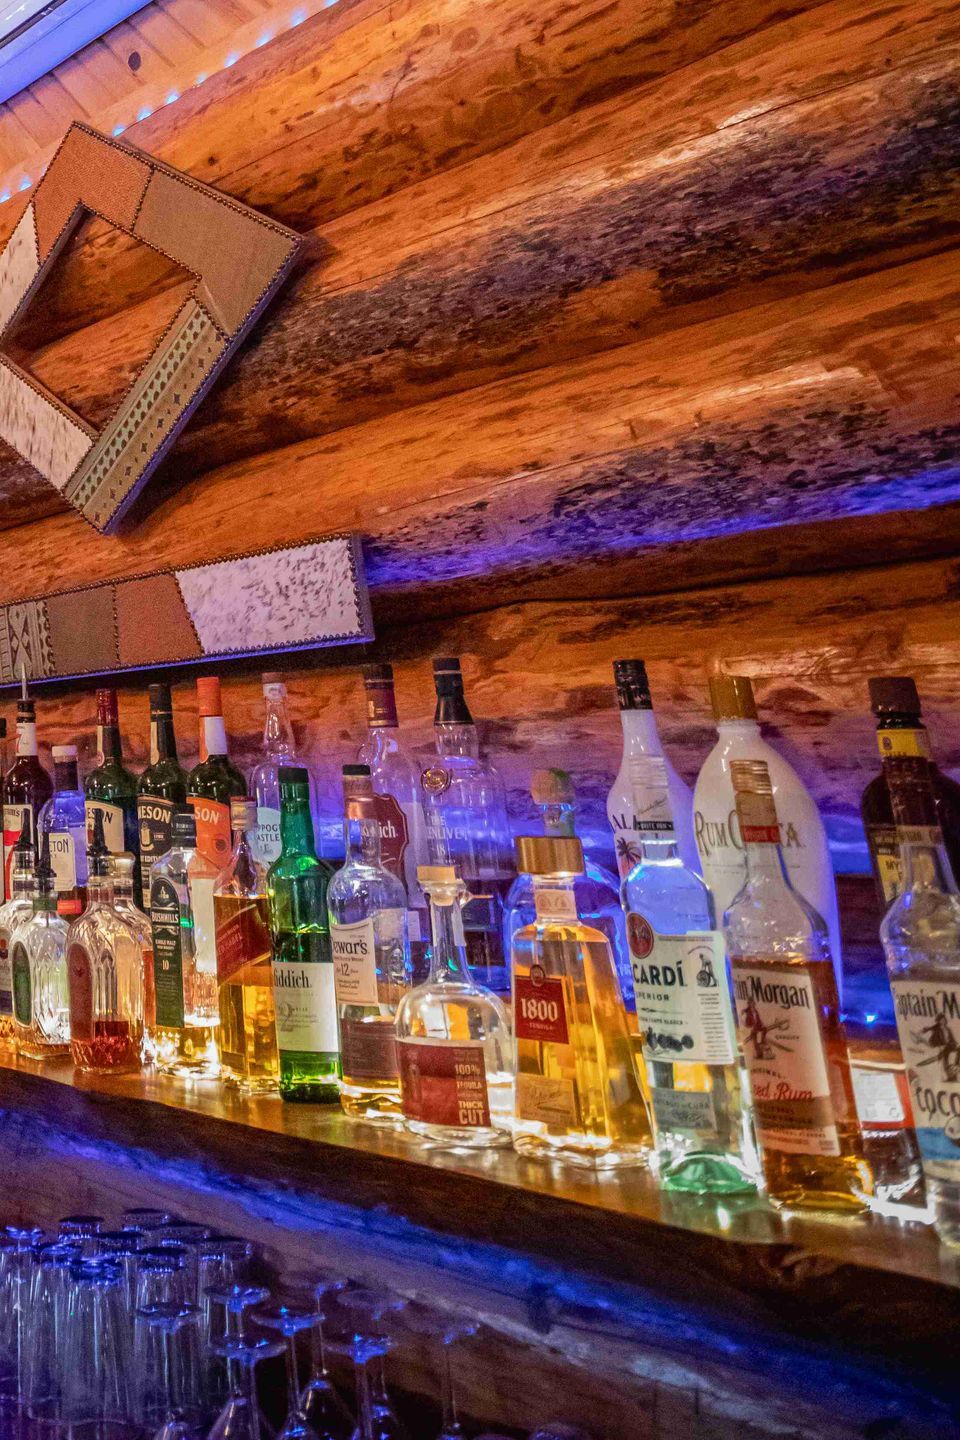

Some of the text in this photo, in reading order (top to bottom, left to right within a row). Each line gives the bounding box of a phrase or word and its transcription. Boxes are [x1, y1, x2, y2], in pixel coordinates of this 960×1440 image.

[87, 807, 114, 824] ESN
[749, 975, 811, 1010] Morgan
[521, 997, 558, 1023] 1800
[458, 1109, 485, 1126] CUT
